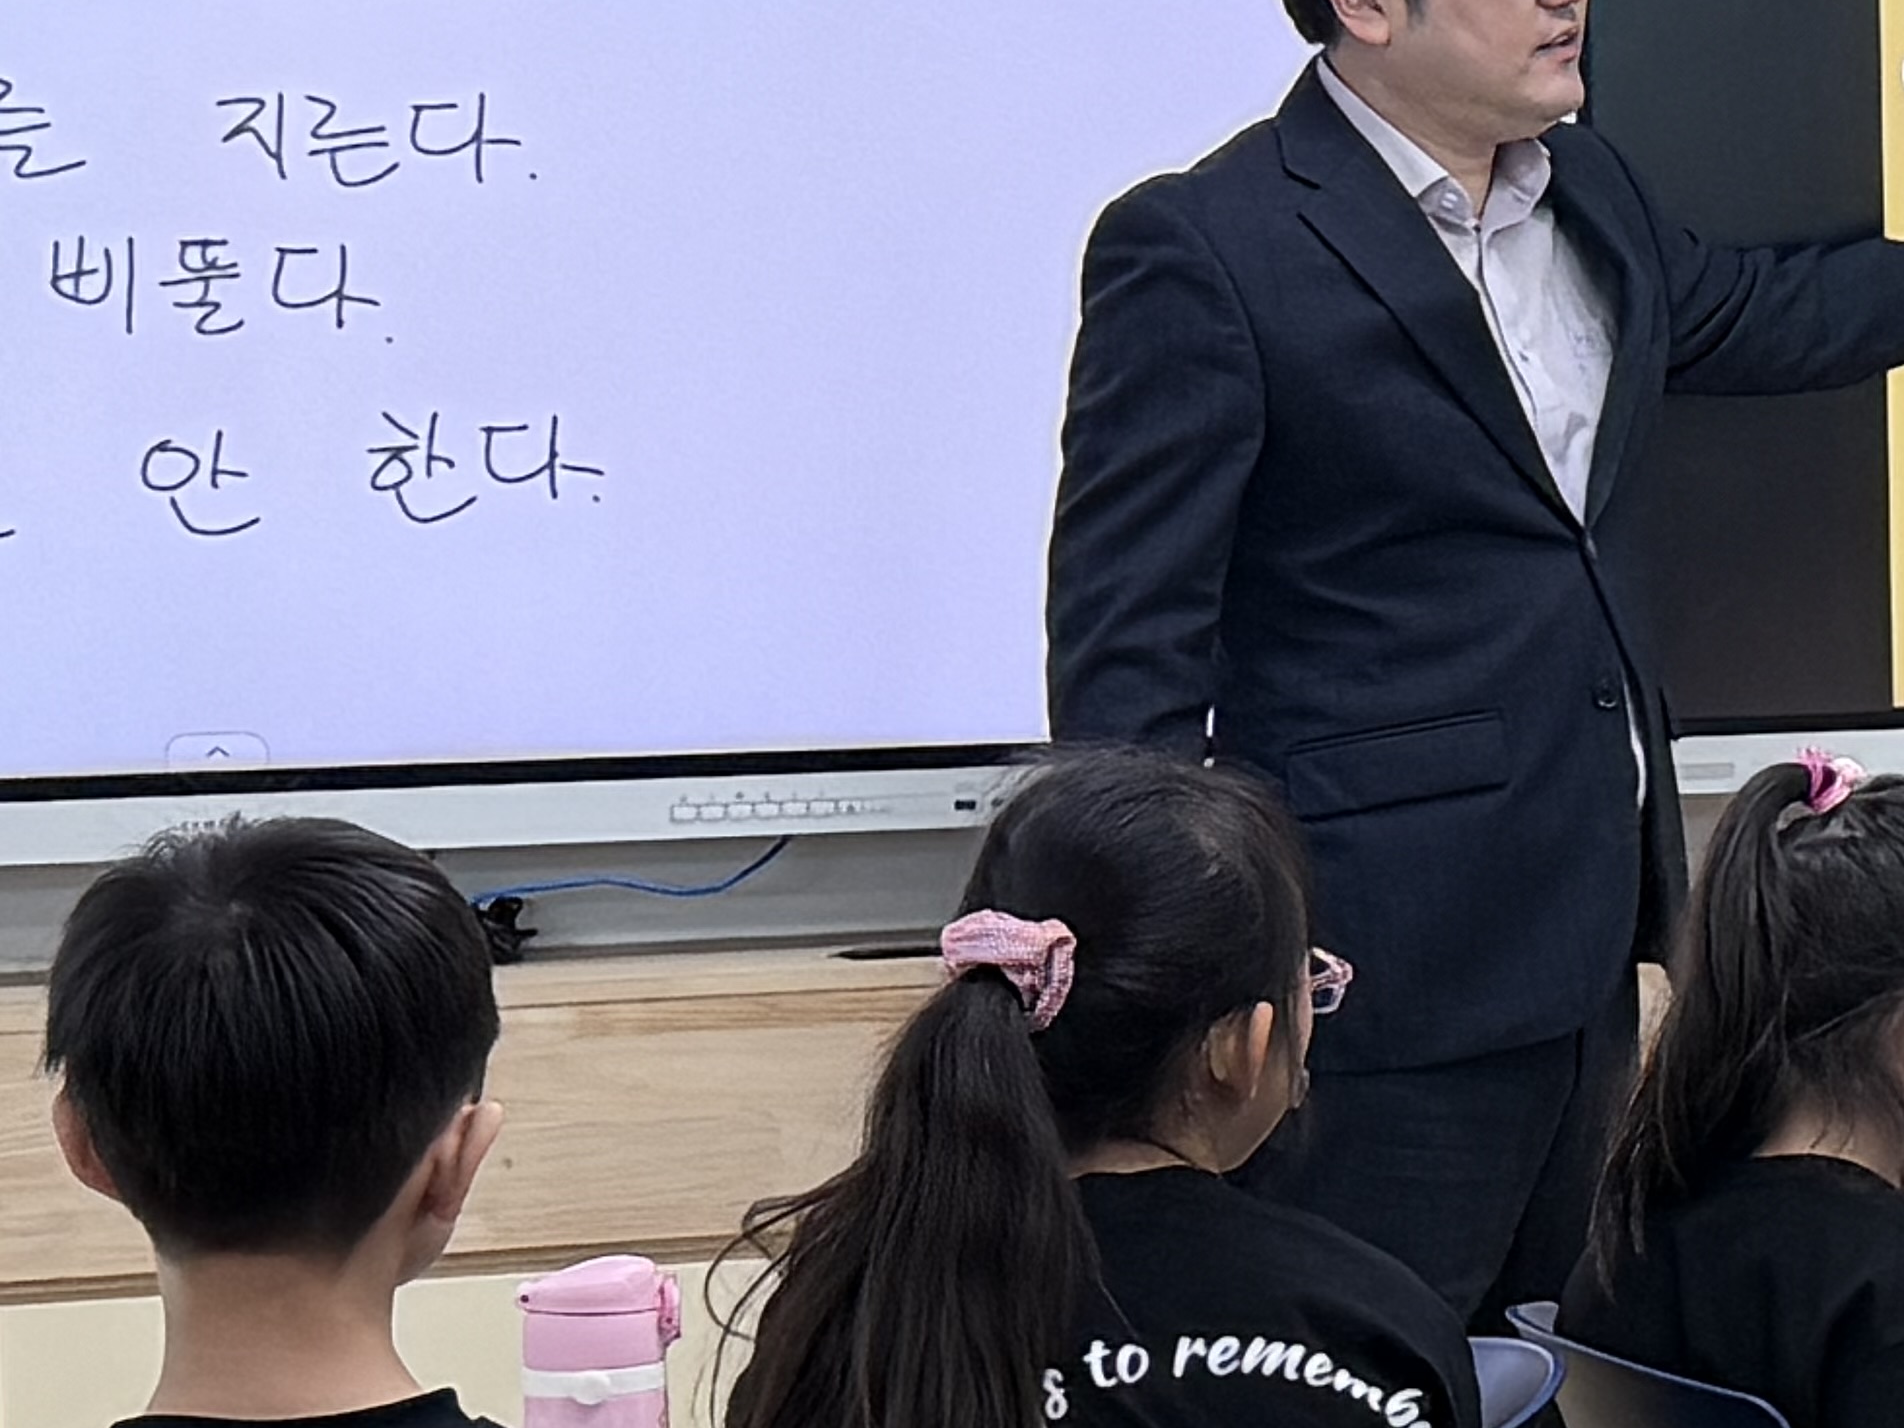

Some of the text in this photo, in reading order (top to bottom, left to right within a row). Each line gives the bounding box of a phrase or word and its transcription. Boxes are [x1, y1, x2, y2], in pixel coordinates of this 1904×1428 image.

[214, 90, 539, 189] 지른다.
[48, 234, 395, 345] 삐뚤다.
[139, 410, 606, 538] 안 한다.
[1081, 1338, 1151, 1389] to
